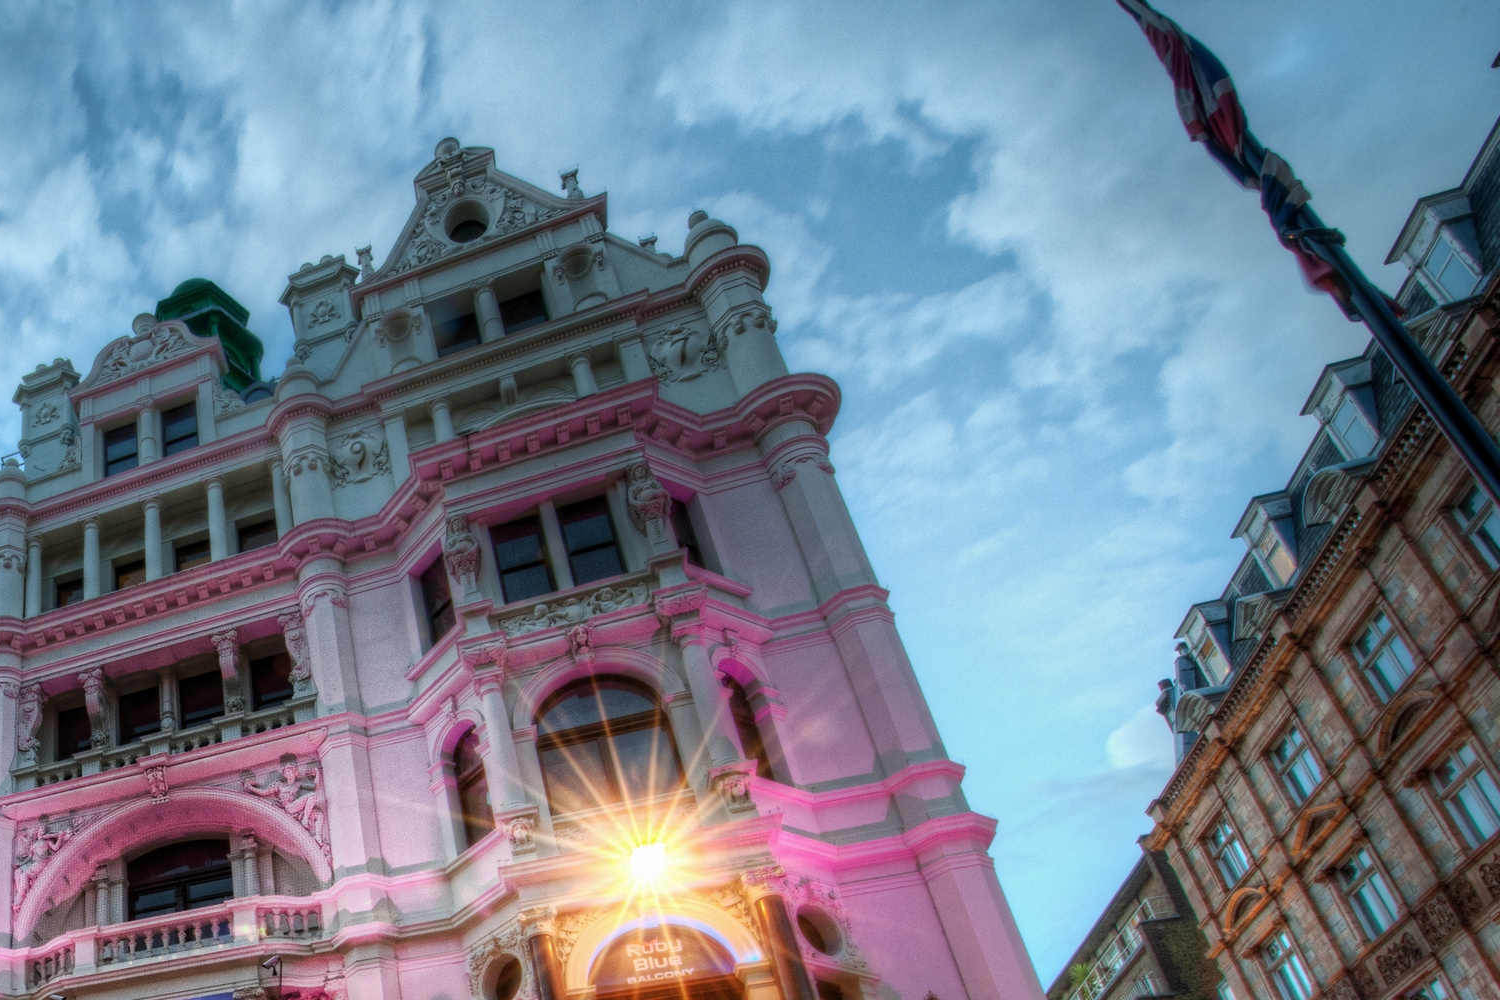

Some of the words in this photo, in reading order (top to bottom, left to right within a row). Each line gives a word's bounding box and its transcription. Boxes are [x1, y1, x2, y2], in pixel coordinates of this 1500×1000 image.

[626, 938, 683, 958] Ruby
[633, 954, 683, 973] Blue
[627, 968, 695, 985] BALCONY
